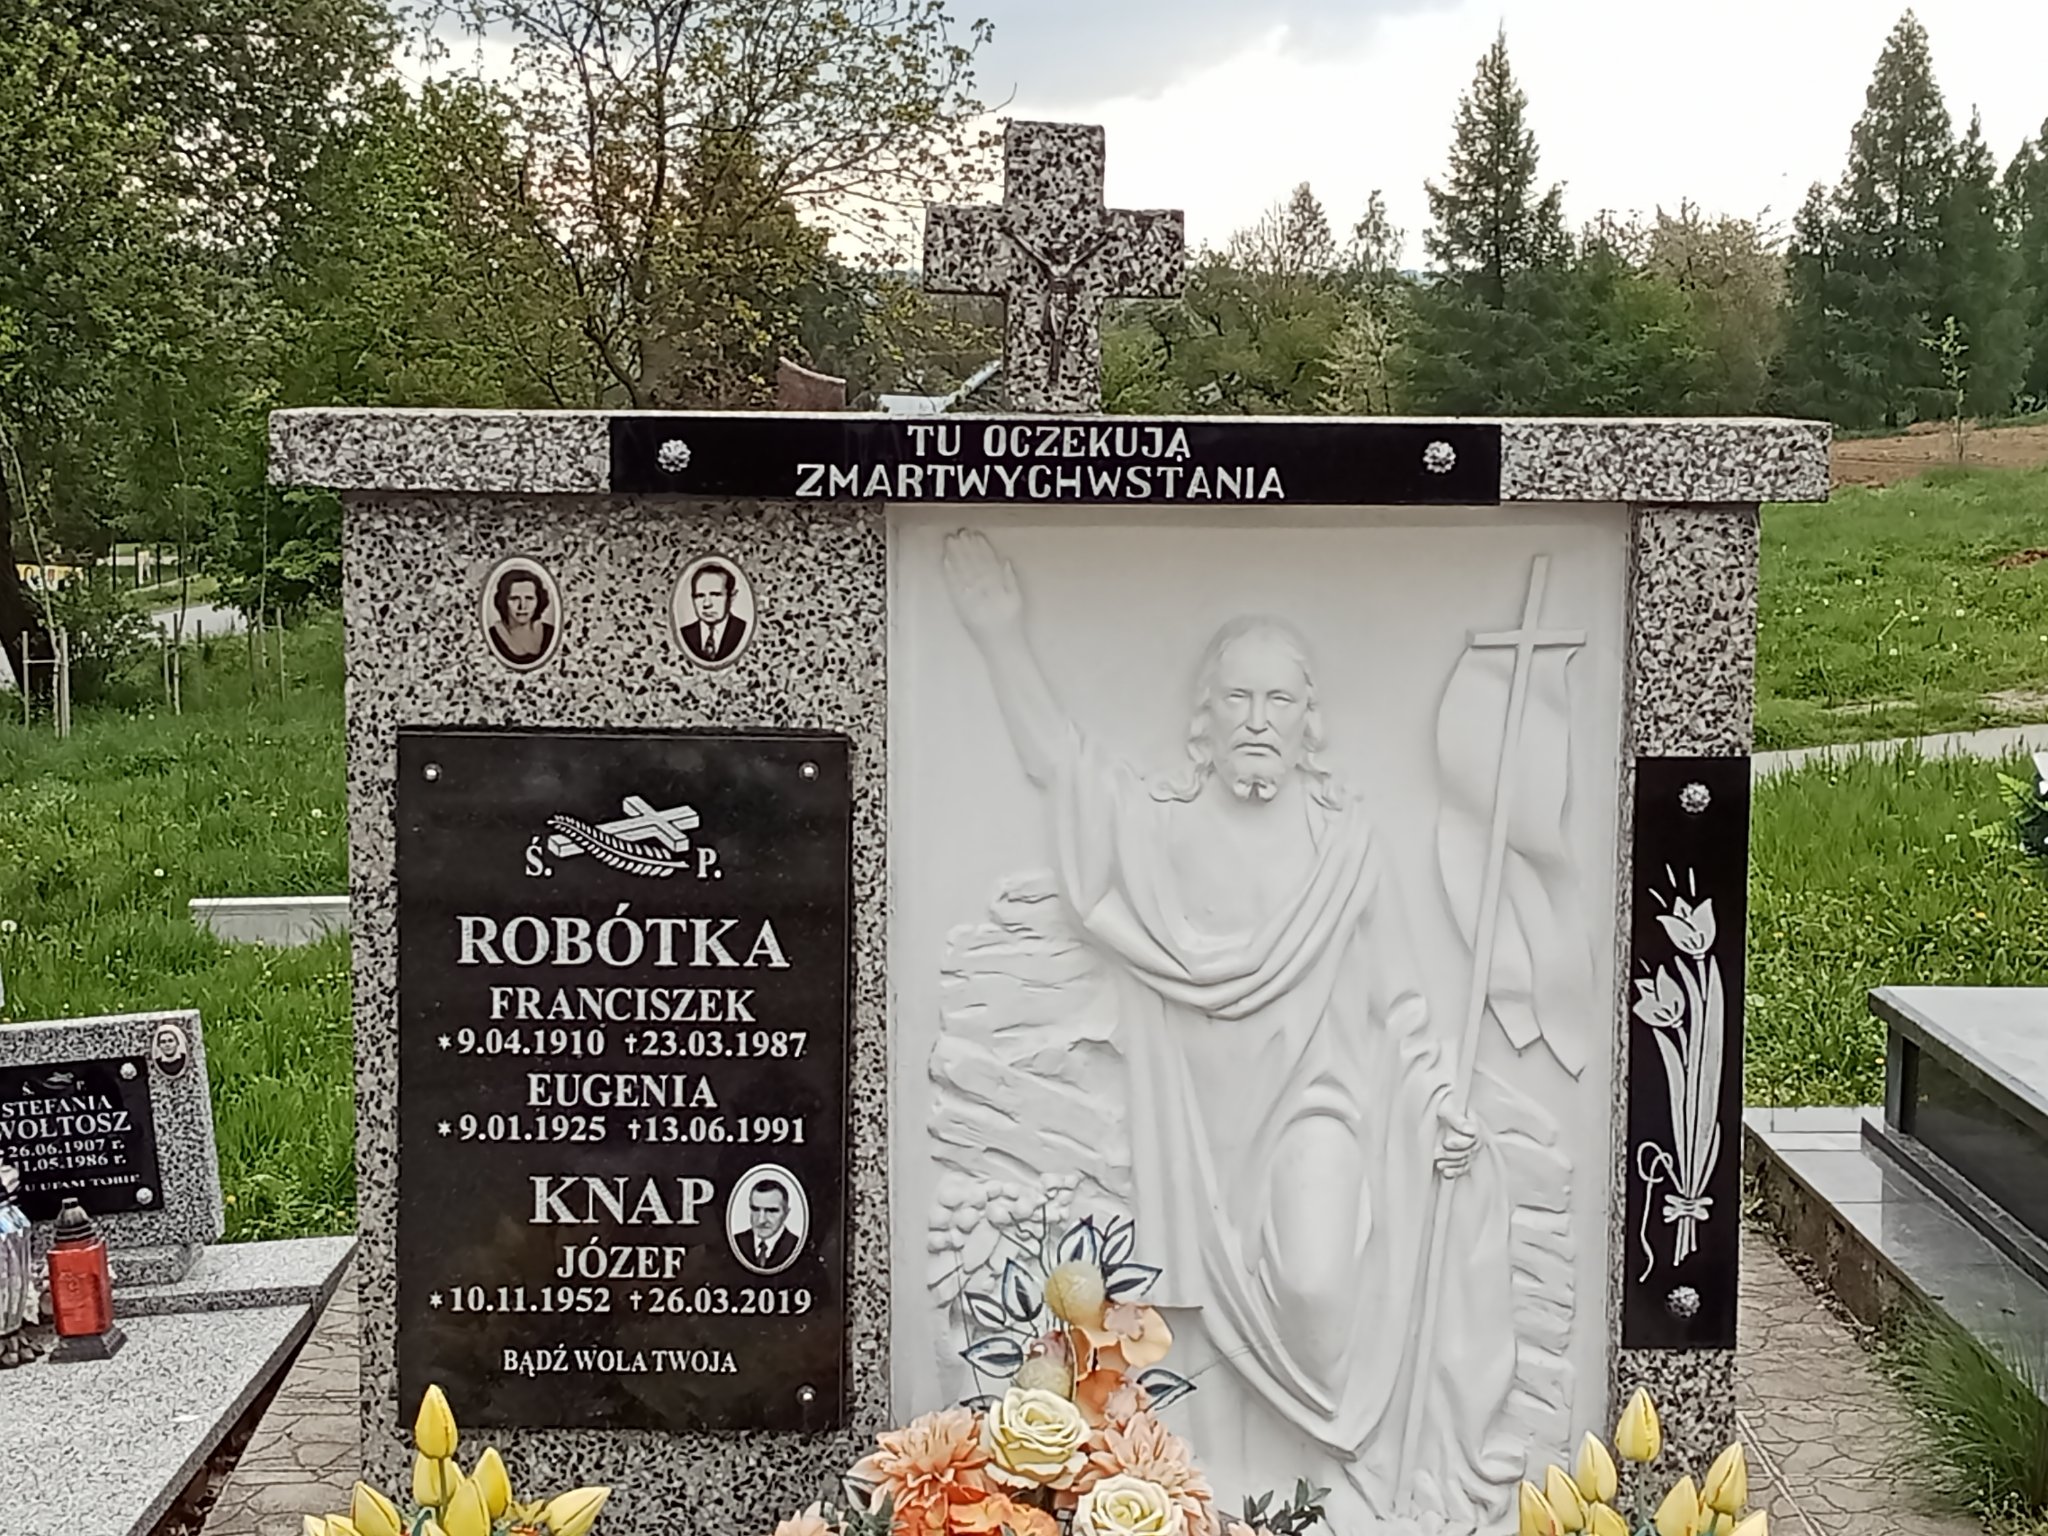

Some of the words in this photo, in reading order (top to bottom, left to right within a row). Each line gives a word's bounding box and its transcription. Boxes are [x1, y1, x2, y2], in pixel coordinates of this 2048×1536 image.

[907, 424, 961, 457] TU
[983, 424, 1192, 462] OCZEKUJĄ
[795, 463, 1285, 499] ZMARTWYCHWSTANIA
[525, 836, 553, 877] Ś.
[697, 847, 722, 879] P.
[456, 902, 791, 968] ROBÓTKA
[490, 986, 756, 1022] FRANCISZEK
[1, 1095, 113, 1118] STEFANIA
[527, 1073, 718, 1109] EUGENIA
[529, 1176, 715, 1225] KNAP
[556, 1237, 686, 1279] JÓZEF
[503, 1344, 569, 1378] BĄDŹ
[574, 1349, 648, 1373] WOLA
[651, 1350, 738, 1373] TWOJA
